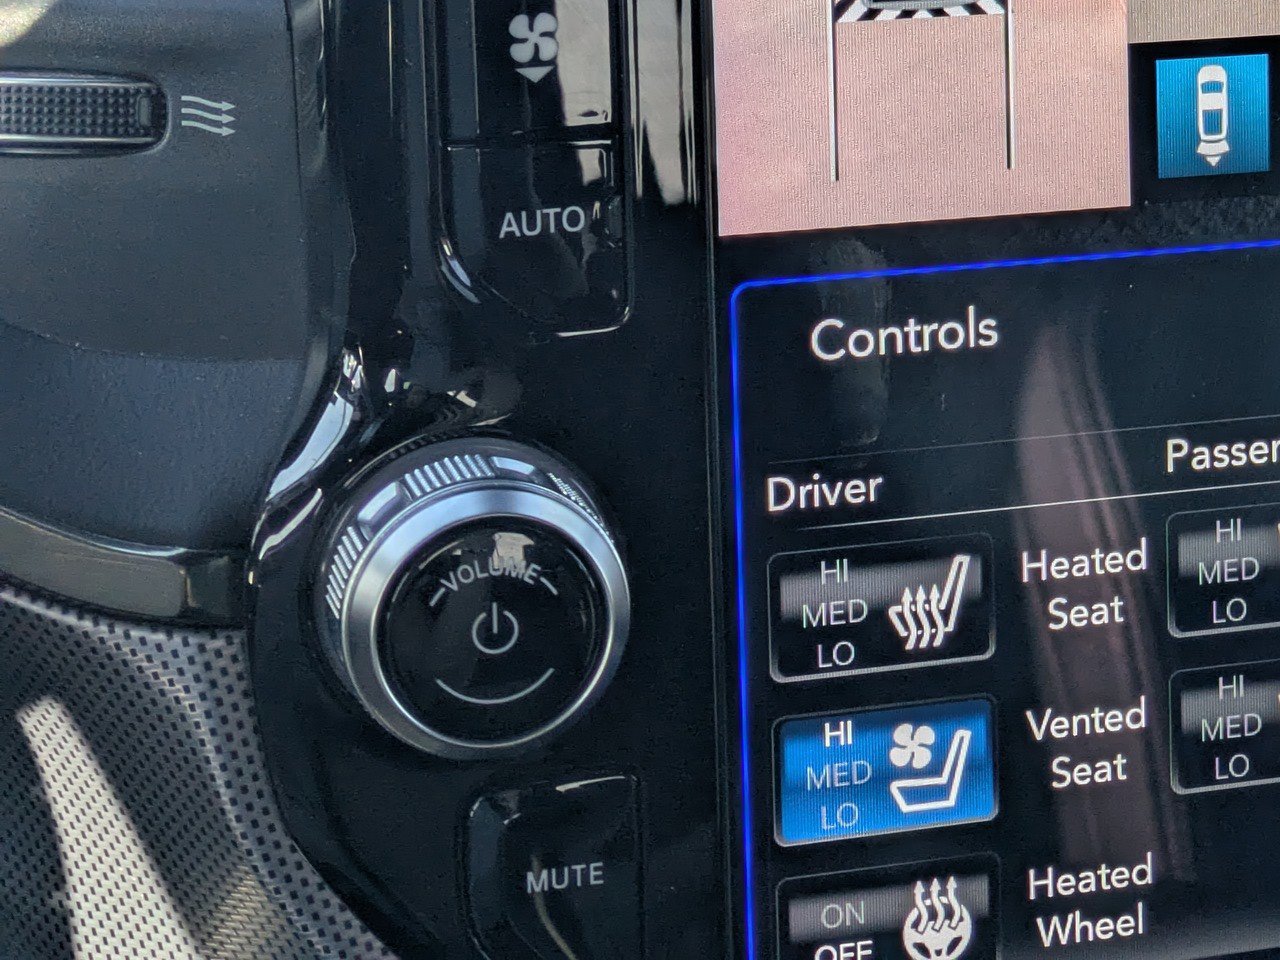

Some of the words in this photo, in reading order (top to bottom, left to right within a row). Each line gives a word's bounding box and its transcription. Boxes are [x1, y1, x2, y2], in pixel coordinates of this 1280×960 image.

[500, 205, 585, 238] AUTO
[811, 305, 999, 361] Controls
[766, 473, 883, 513] Driver
[1216, 519, 1241, 543] HI
[821, 559, 849, 584] HI
[1021, 538, 1148, 583] Heated
[1198, 557, 1259, 585] MED
[441, 560, 542, 592] VOLUME
[802, 599, 868, 627] MED
[1047, 600, 1123, 629] Seat
[1212, 598, 1247, 624] LO
[817, 642, 854, 669] LO
[1218, 675, 1244, 699] HI
[1027, 696, 1146, 741] Vented
[1200, 713, 1261, 741] MED
[824, 721, 853, 746] HI
[806, 761, 872, 790] MED
[1050, 758, 1126, 787] Seat
[1214, 754, 1249, 780] LO
[820, 803, 859, 830] LO
[526, 862, 604, 894] MUTE
[1028, 853, 1153, 899] Heated
[820, 901, 865, 928] ON
[1036, 902, 1144, 946] Wheel
